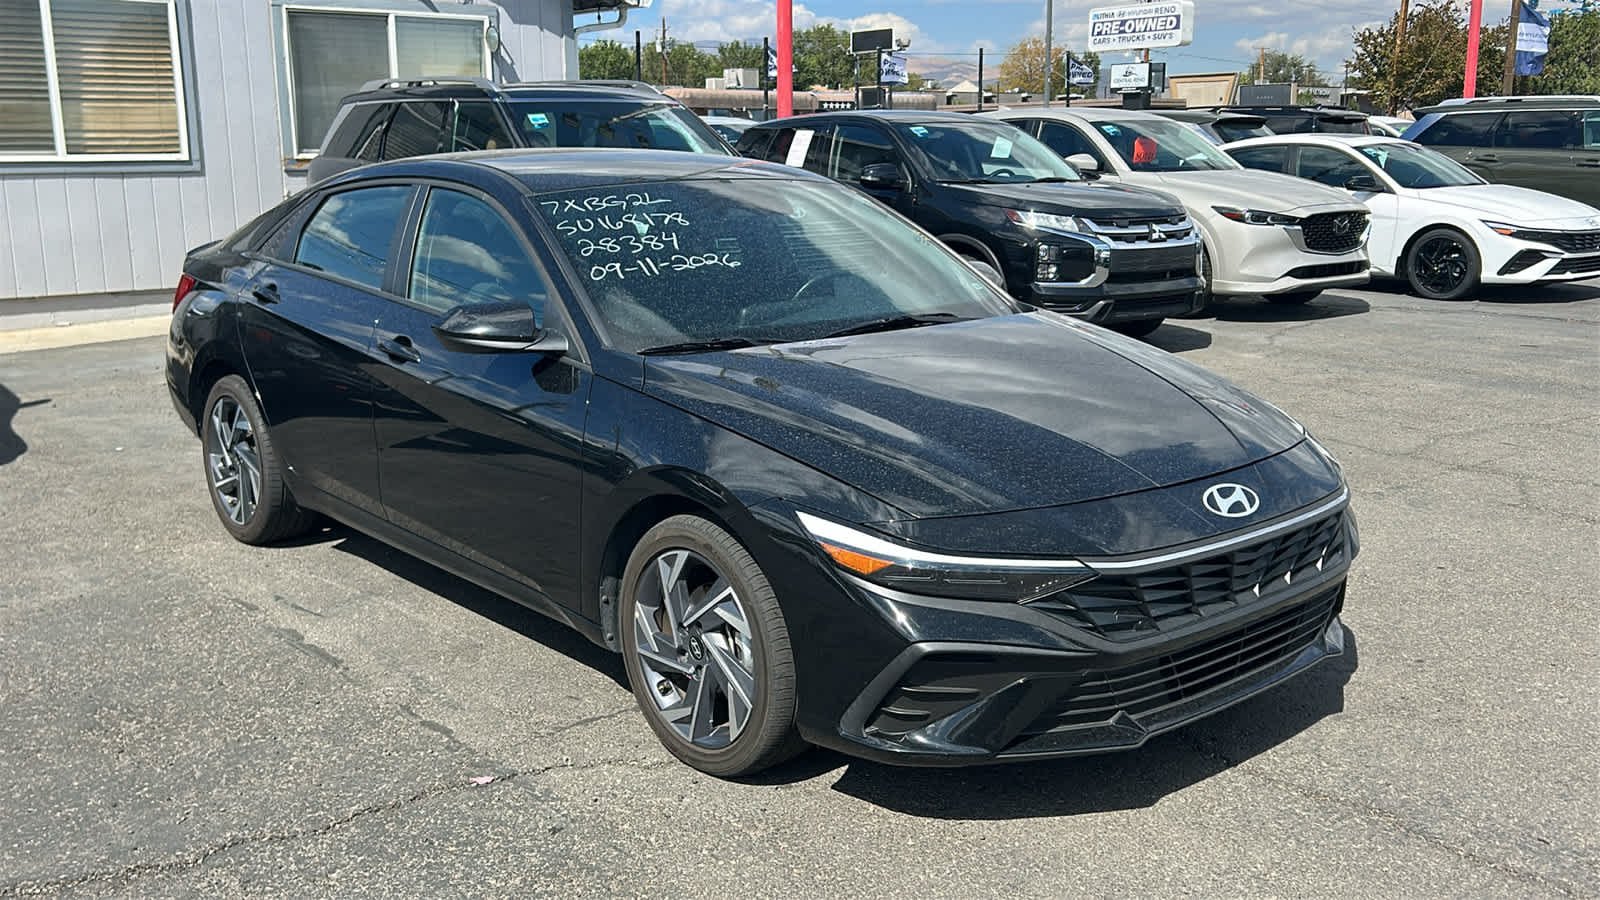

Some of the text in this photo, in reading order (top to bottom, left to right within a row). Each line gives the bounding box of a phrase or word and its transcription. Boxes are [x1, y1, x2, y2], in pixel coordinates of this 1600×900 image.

[1154, 5, 1176, 15] RENO
[1093, 16, 1177, 36] PRE-OWNED
[1093, 37, 1110, 45] CARS
[1118, 34, 1145, 43] TRUCKS
[577, 232, 680, 256] 28384
[590, 253, 742, 280] 09-11-2026
